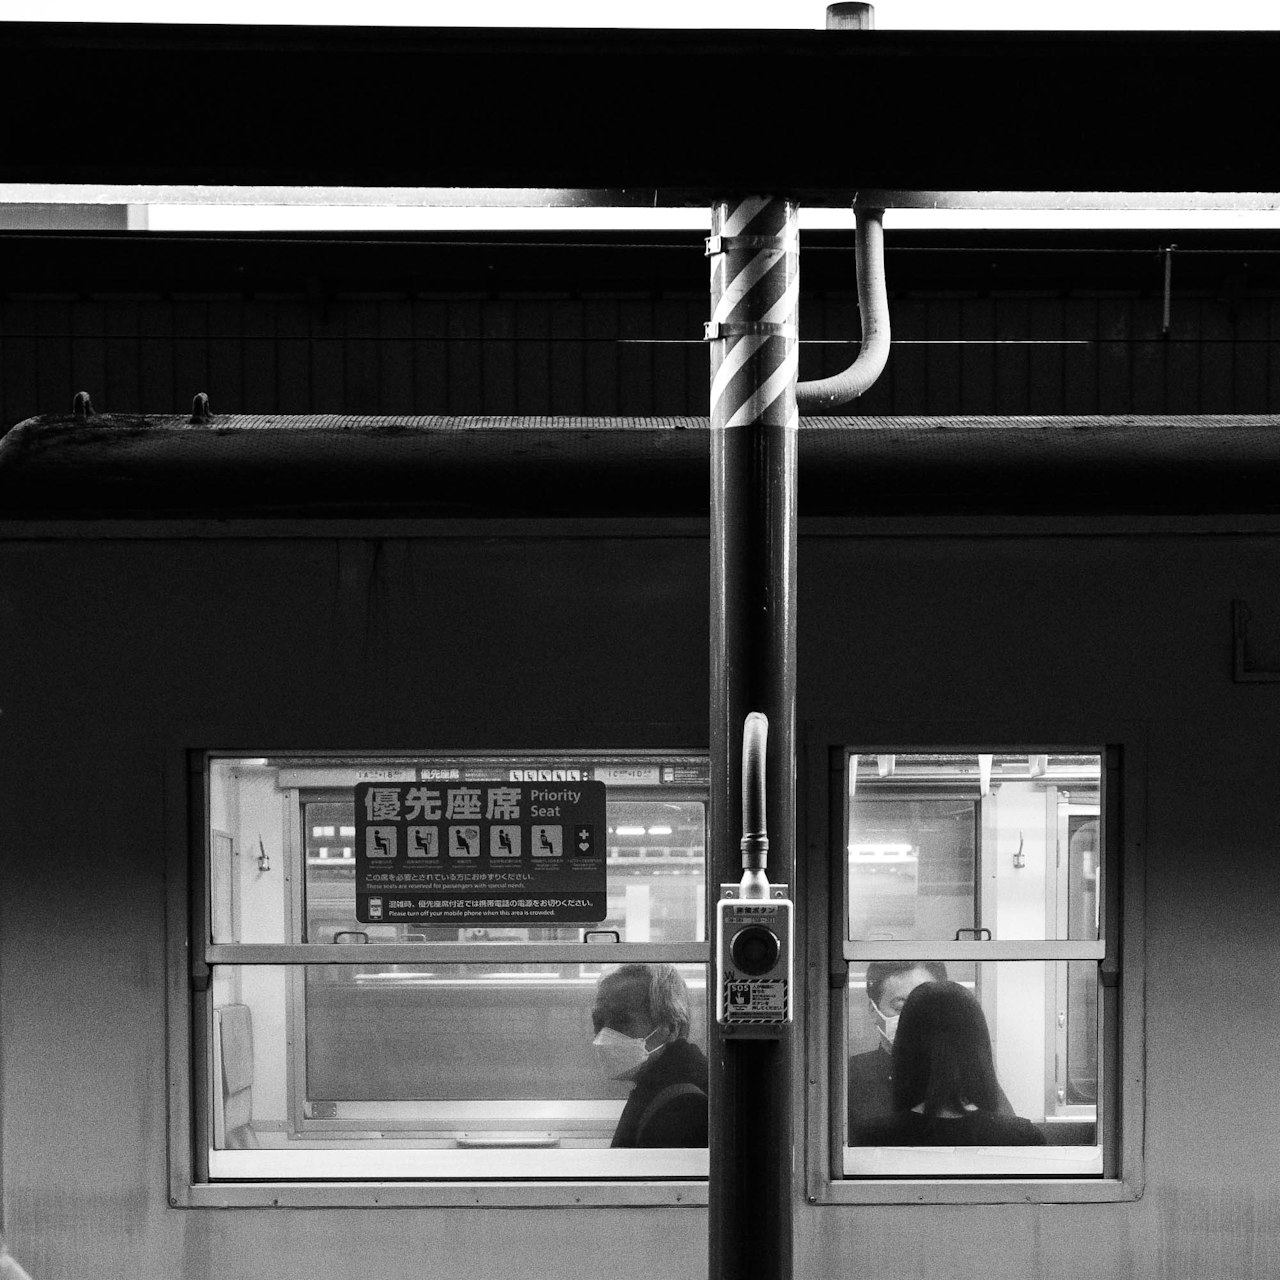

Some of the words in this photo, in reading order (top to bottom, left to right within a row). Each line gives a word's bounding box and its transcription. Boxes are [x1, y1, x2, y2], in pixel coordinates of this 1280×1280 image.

[364, 786, 522, 822] 優先座席
[530, 789, 582, 805] Priority
[530, 805, 561, 818] Seat
